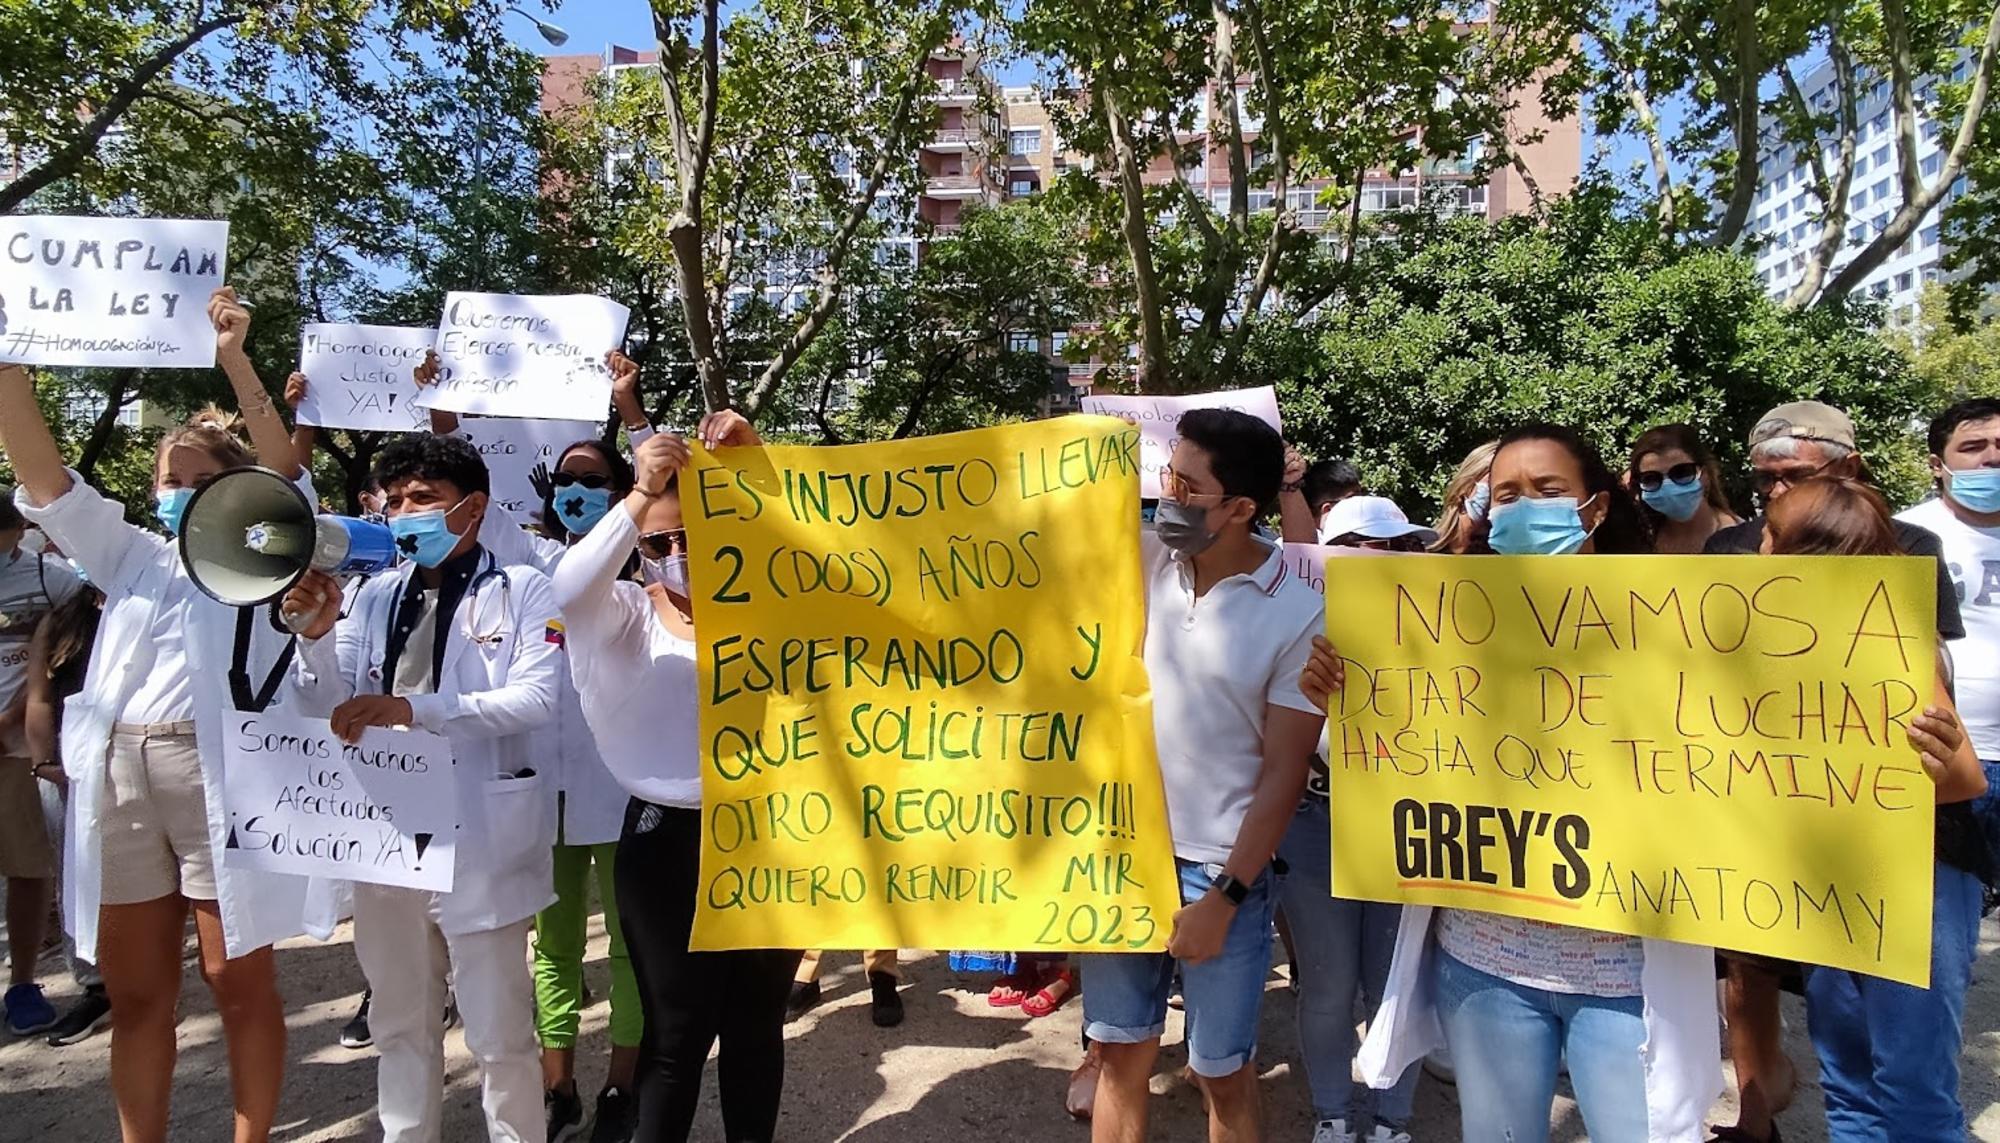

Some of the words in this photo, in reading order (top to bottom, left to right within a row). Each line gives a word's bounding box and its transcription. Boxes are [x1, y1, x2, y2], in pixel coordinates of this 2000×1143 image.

[29, 286, 75, 312] LA
[109, 292, 180, 318] LEY
[449, 297, 551, 332] Queremos
[340, 363, 399, 385] Justa
[443, 331, 515, 360] Ejercer
[698, 467, 763, 521] ES
[784, 457, 998, 526] INJUSTO
[1018, 429, 1141, 501] LLEVAR
[711, 545, 751, 603] 2
[767, 545, 892, 607] (DOS)
[918, 530, 1041, 602] AÑOS
[1396, 578, 1496, 646] NO
[1521, 576, 1818, 657] VAMOS
[1844, 579, 1919, 673] A
[711, 628, 1024, 706] ESPERANDO
[1337, 656, 1487, 732] DEJAR
[1533, 666, 1613, 733] DE
[1675, 671, 1918, 748] LUCHAR
[239, 720, 331, 759] Somos
[342, 743, 429, 774] muchos
[712, 715, 819, 781] QUE
[1341, 722, 1476, 776] HASTA
[1494, 733, 1593, 790] QUE
[1611, 739, 1923, 811] TERMINE
[275, 785, 395, 823] Afectados
[308, 764, 345, 791] los
[710, 791, 833, 854] OTRO
[708, 865, 867, 911] QUIERO
[1393, 798, 1591, 900] GREY'S
[1595, 861, 1887, 962] ANATOMY
[1034, 901, 1157, 948] 2023
